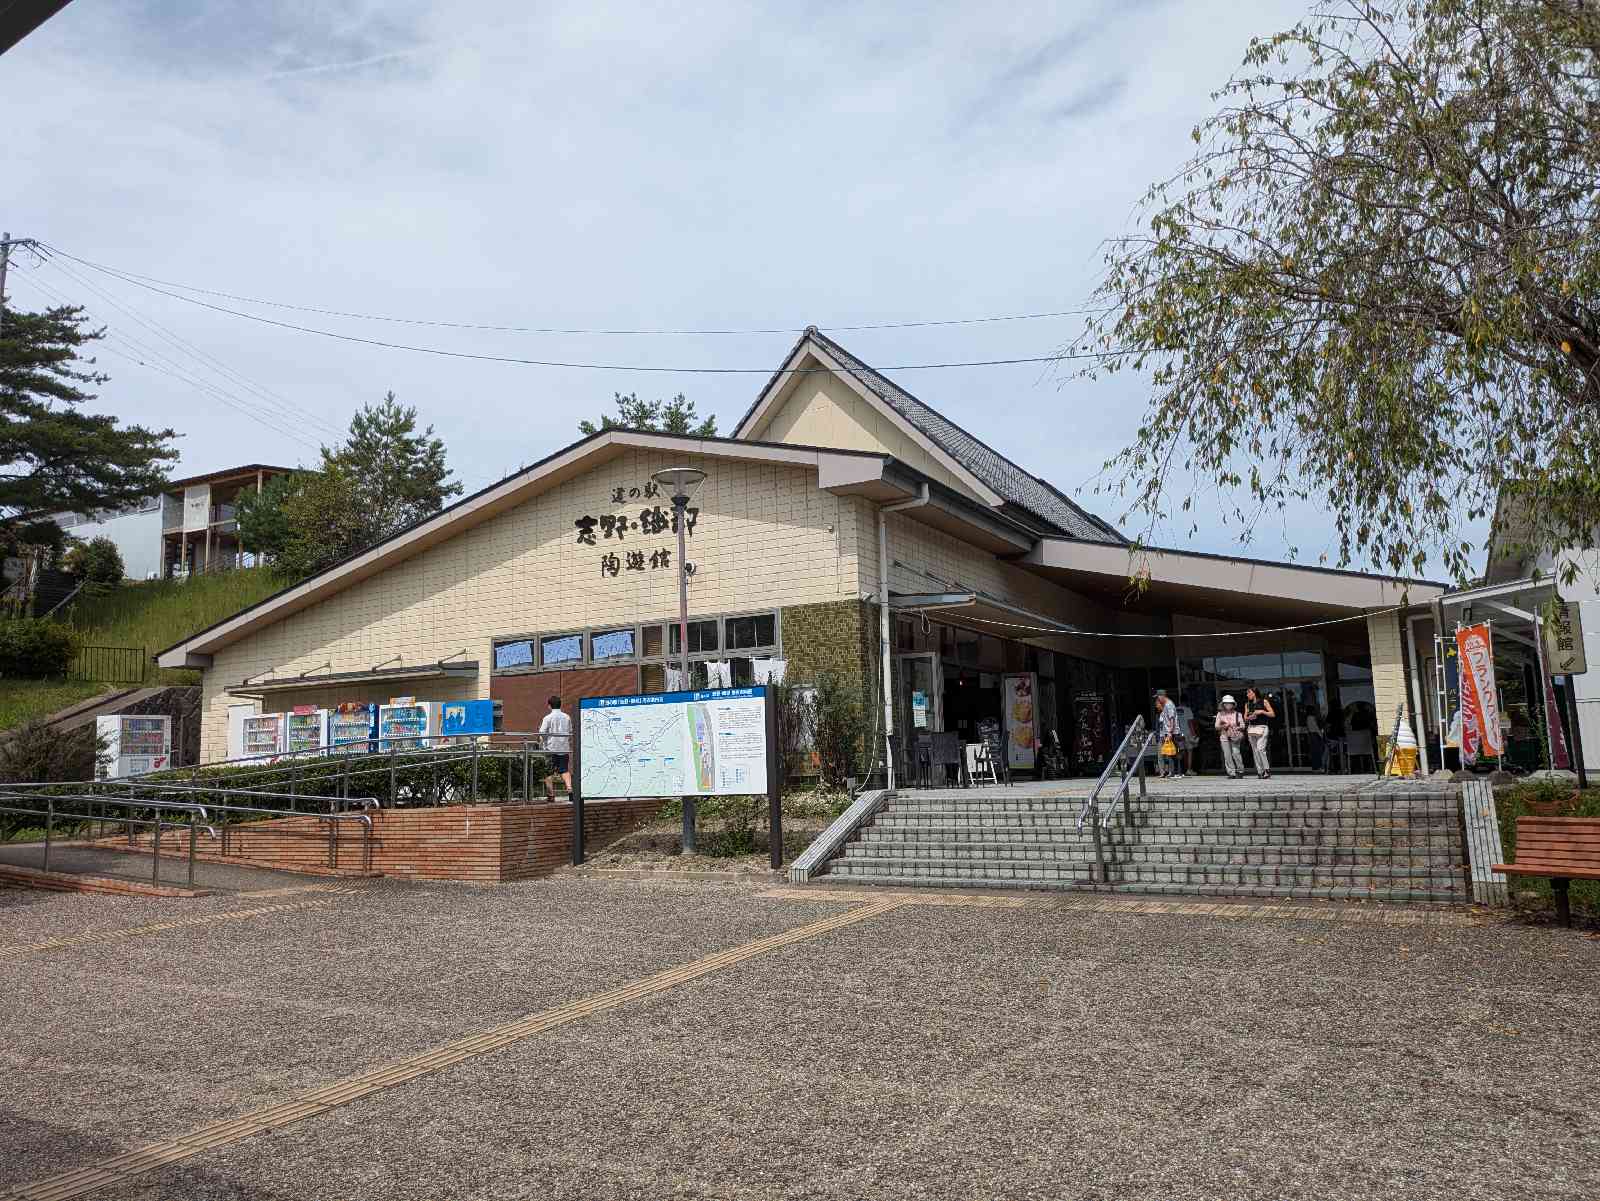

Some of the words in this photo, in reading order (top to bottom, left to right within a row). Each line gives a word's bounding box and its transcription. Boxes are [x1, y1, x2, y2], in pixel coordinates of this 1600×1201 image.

[612, 481, 660, 504] 道の駅
[601, 548, 671, 578] 陶遊館
